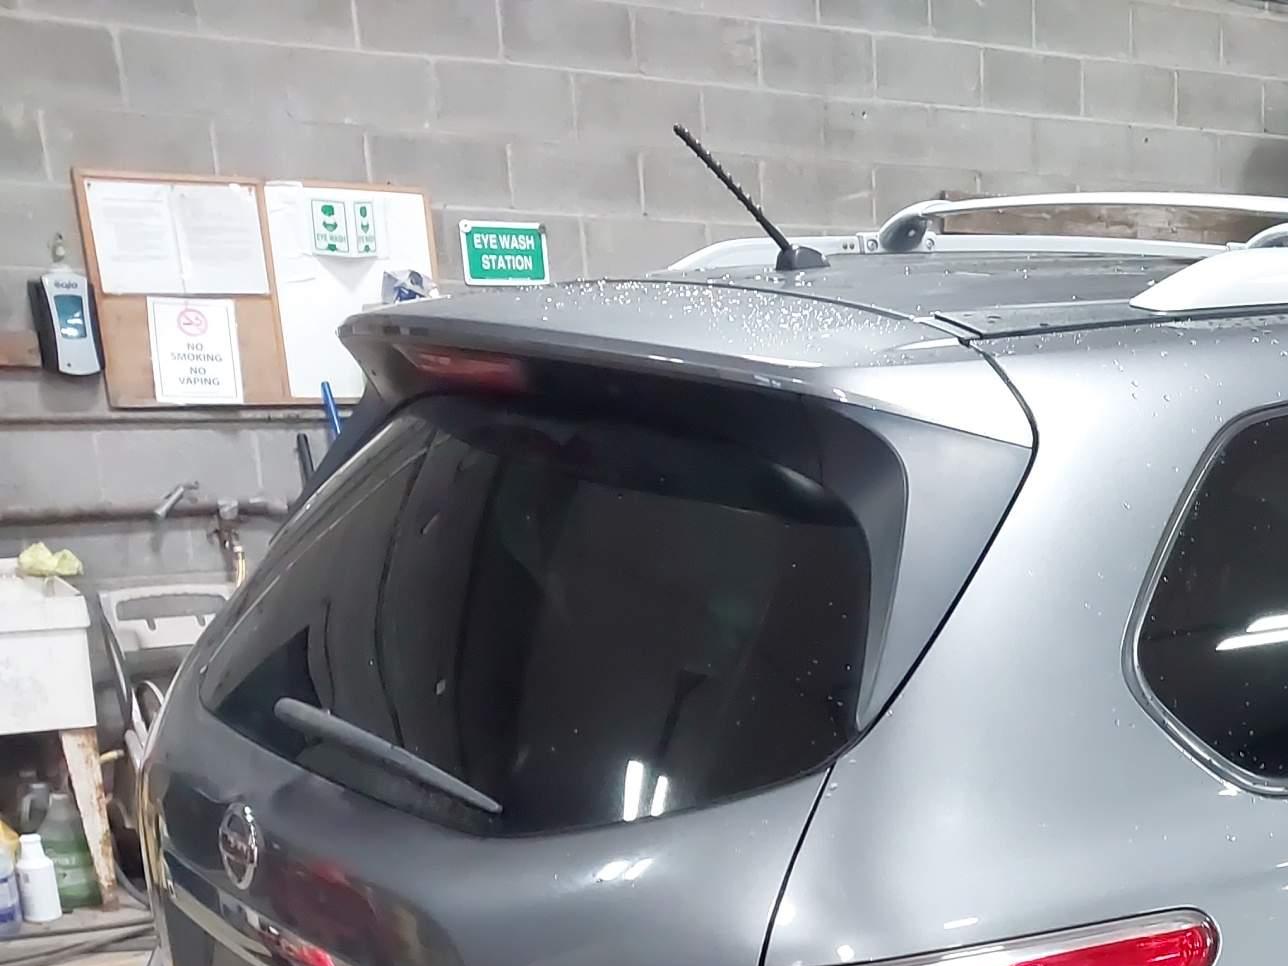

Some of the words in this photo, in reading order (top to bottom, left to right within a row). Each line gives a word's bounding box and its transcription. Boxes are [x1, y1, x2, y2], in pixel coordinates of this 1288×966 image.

[473, 233, 498, 249] EYE
[499, 234, 535, 250] WASH
[481, 254, 533, 271] STATION
[186, 342, 203, 351] NO
[170, 352, 223, 362] SMOKING
[189, 366, 206, 375] NO
[178, 377, 220, 386] VAPING
